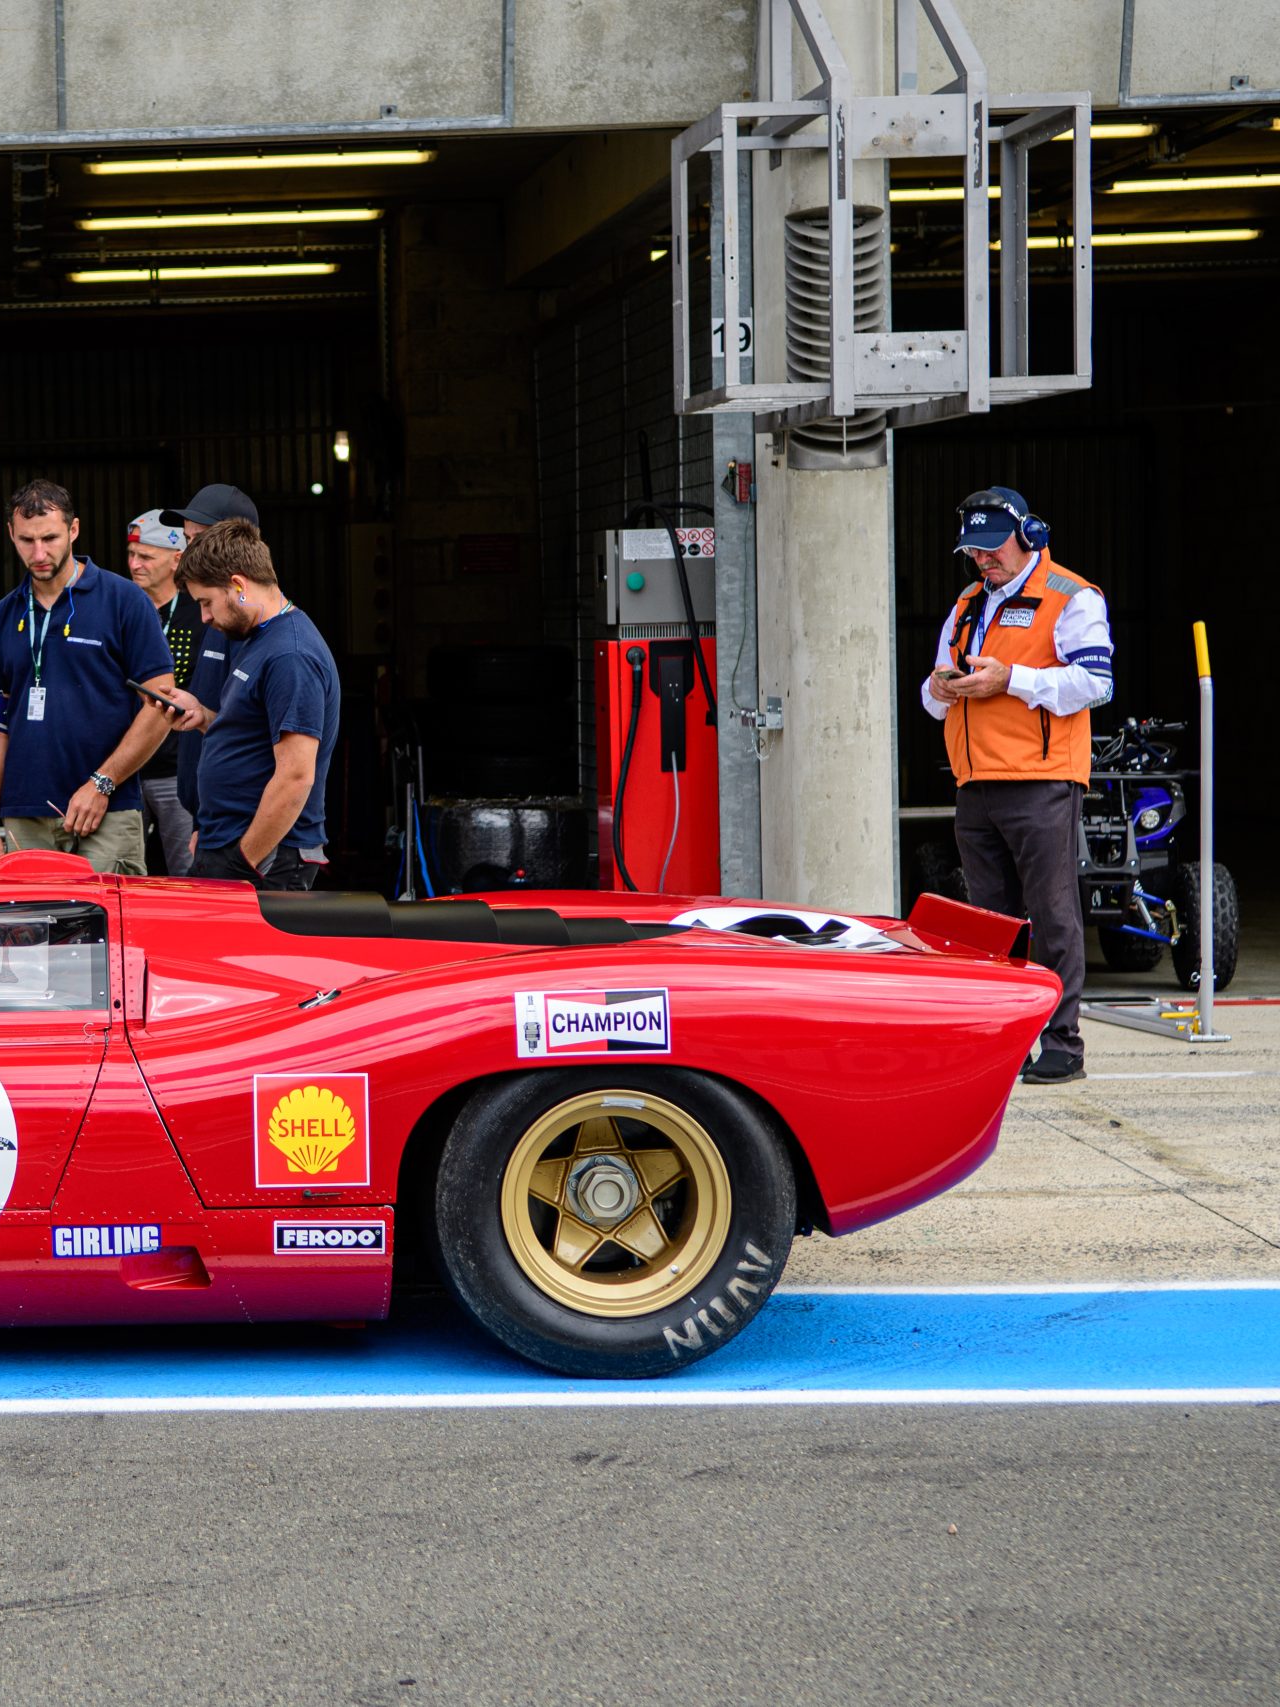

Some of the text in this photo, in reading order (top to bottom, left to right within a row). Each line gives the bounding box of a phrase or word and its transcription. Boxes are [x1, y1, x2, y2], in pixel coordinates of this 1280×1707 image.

[713, 322, 751, 352] 19
[552, 1010, 662, 1034] CHAMPION
[278, 1118, 346, 1139] SHELL
[55, 1226, 159, 1257] GIRLING
[283, 1230, 376, 1246] FERODO
[663, 1239, 773, 1358] AVON
